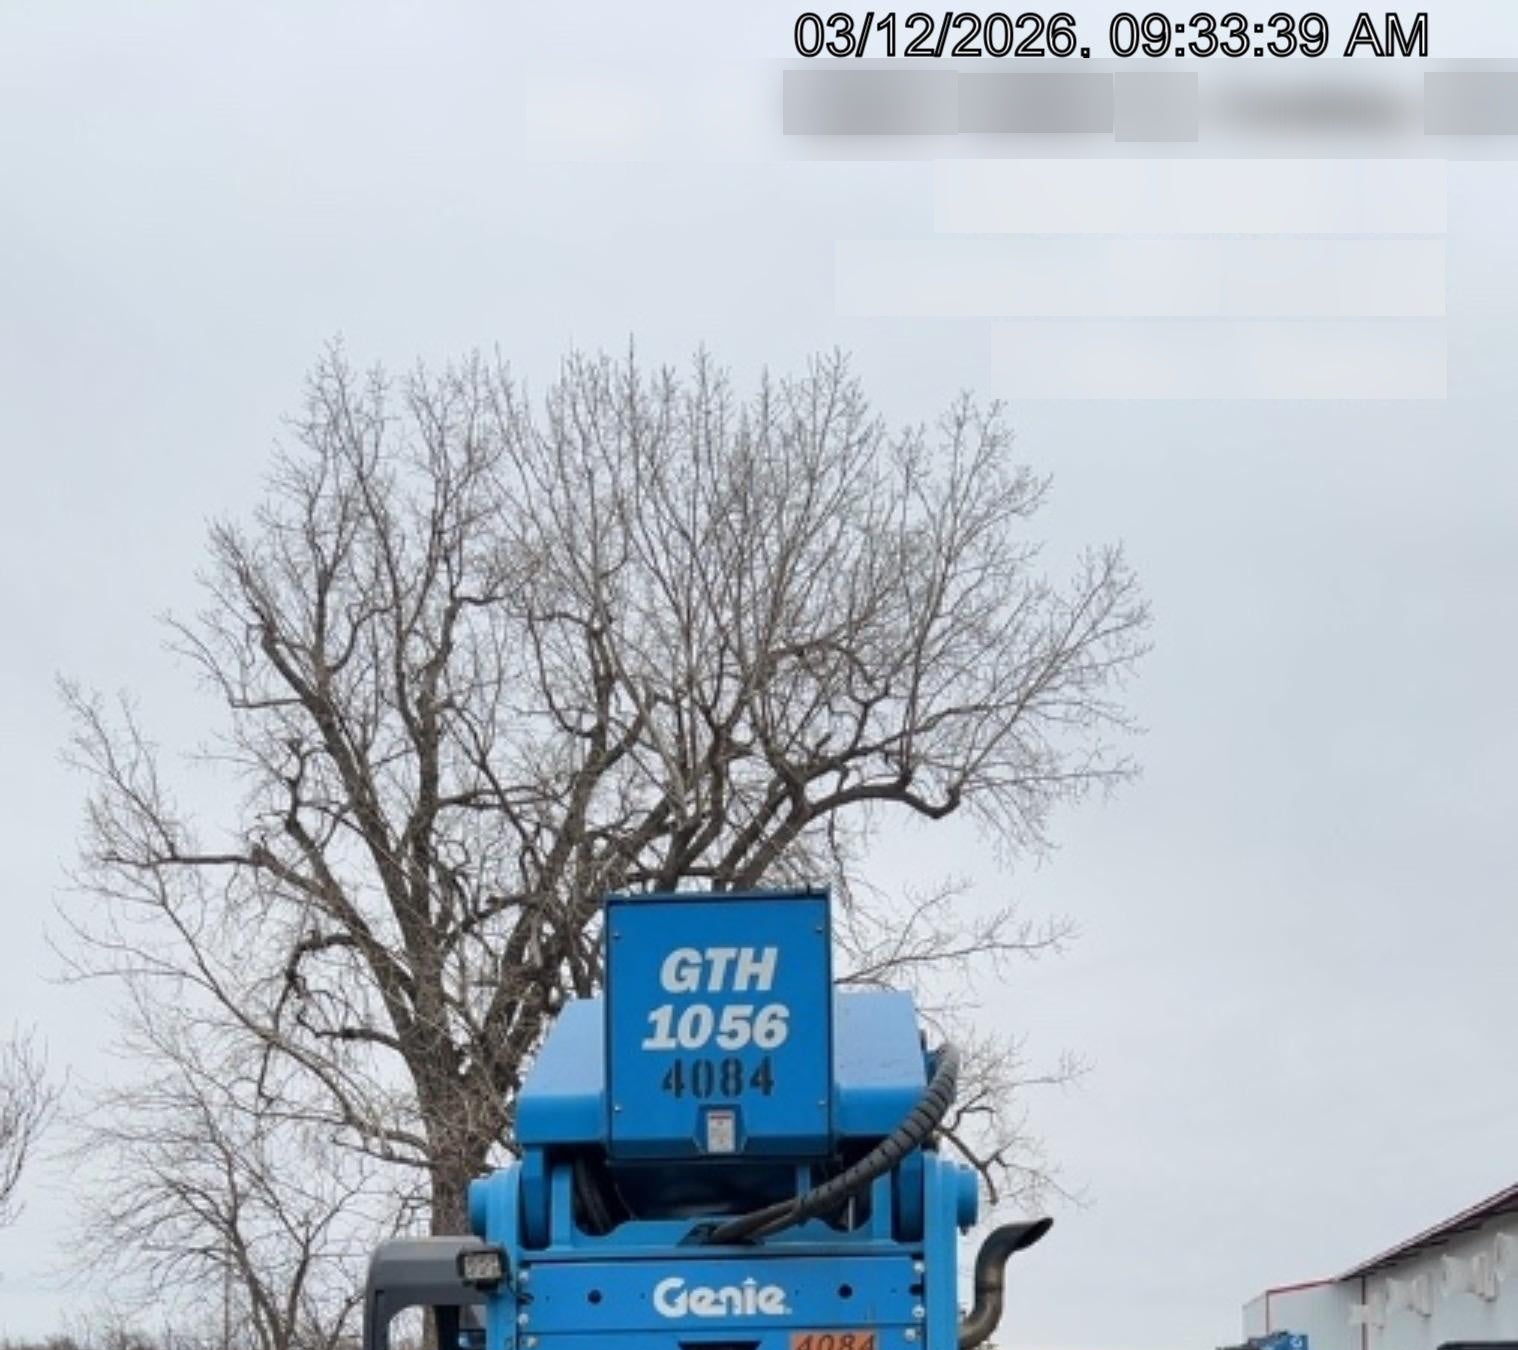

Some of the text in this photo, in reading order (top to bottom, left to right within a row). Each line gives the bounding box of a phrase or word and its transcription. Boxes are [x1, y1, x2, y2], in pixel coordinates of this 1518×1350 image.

[660, 947, 779, 993] GTH
[641, 1003, 790, 1050] 1056
[662, 1056, 775, 1099] 4084
[653, 1277, 787, 1318] Genie
